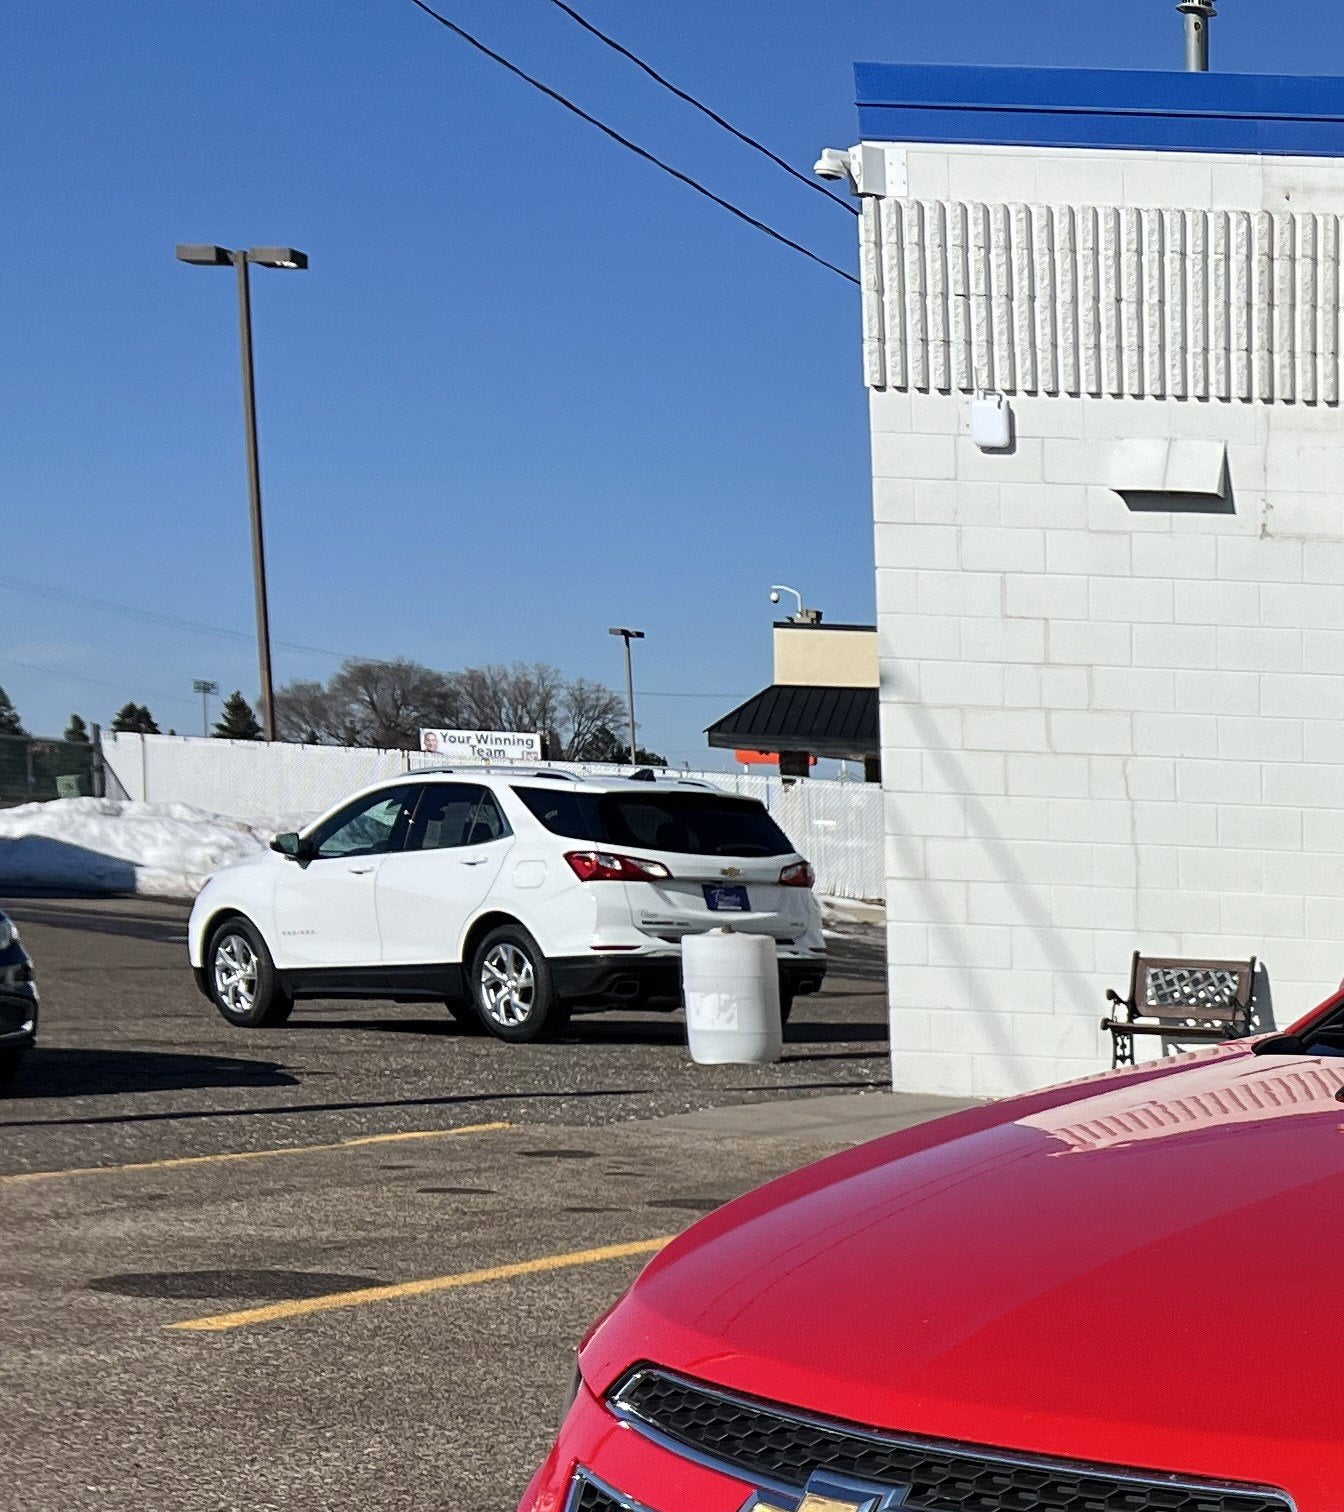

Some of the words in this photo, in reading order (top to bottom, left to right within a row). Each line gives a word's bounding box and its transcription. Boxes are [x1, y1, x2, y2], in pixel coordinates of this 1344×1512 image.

[440, 731, 472, 744] Your
[475, 733, 534, 749] Winning
[470, 745, 506, 758] Team
